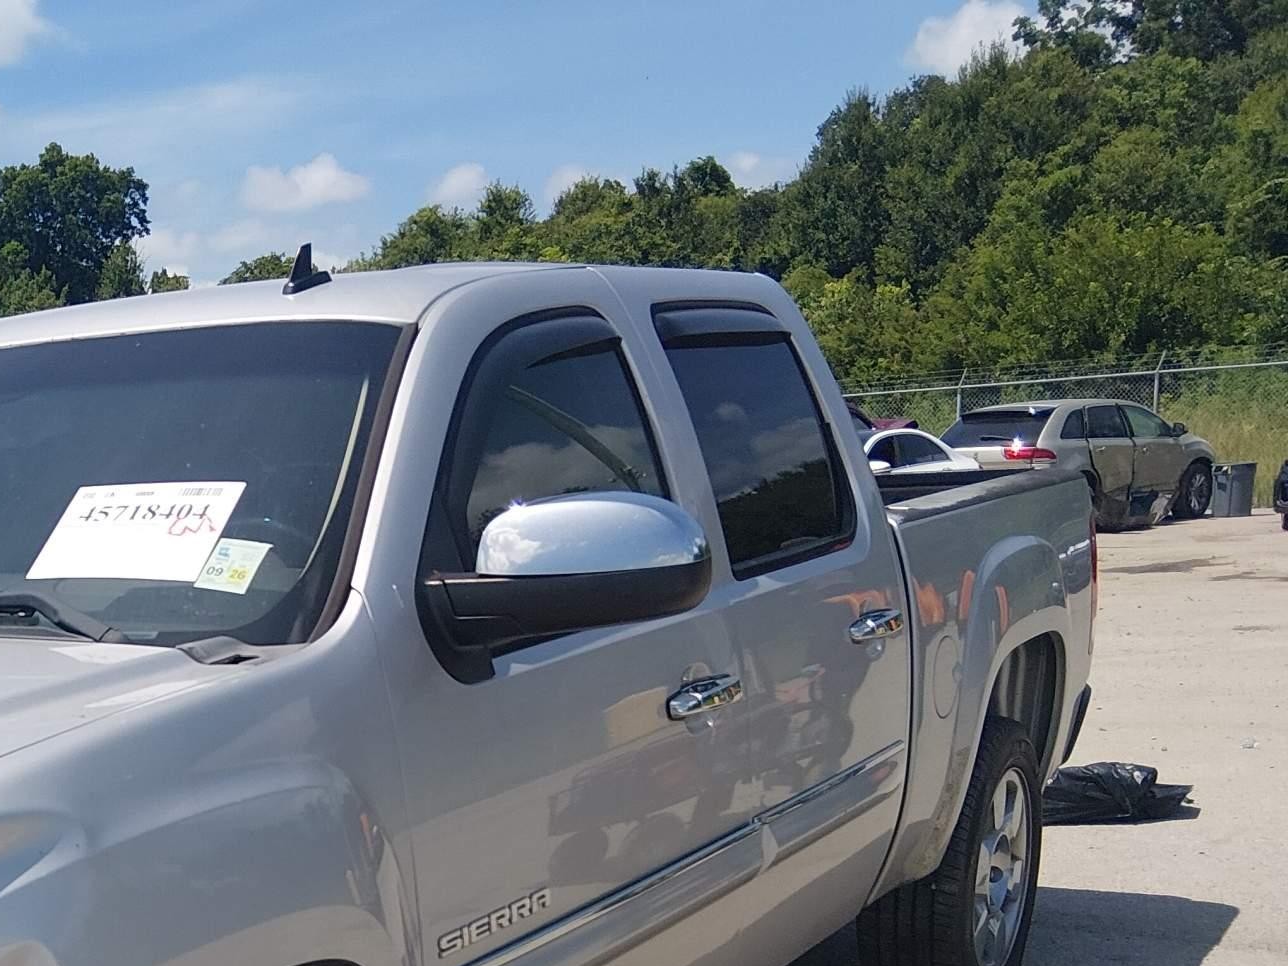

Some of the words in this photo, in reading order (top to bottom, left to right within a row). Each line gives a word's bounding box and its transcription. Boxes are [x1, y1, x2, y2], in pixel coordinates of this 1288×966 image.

[80, 504, 210, 521] 45718404
[206, 566, 224, 577] 09
[228, 569, 248, 580] 26
[438, 887, 551, 959] SIERRA
